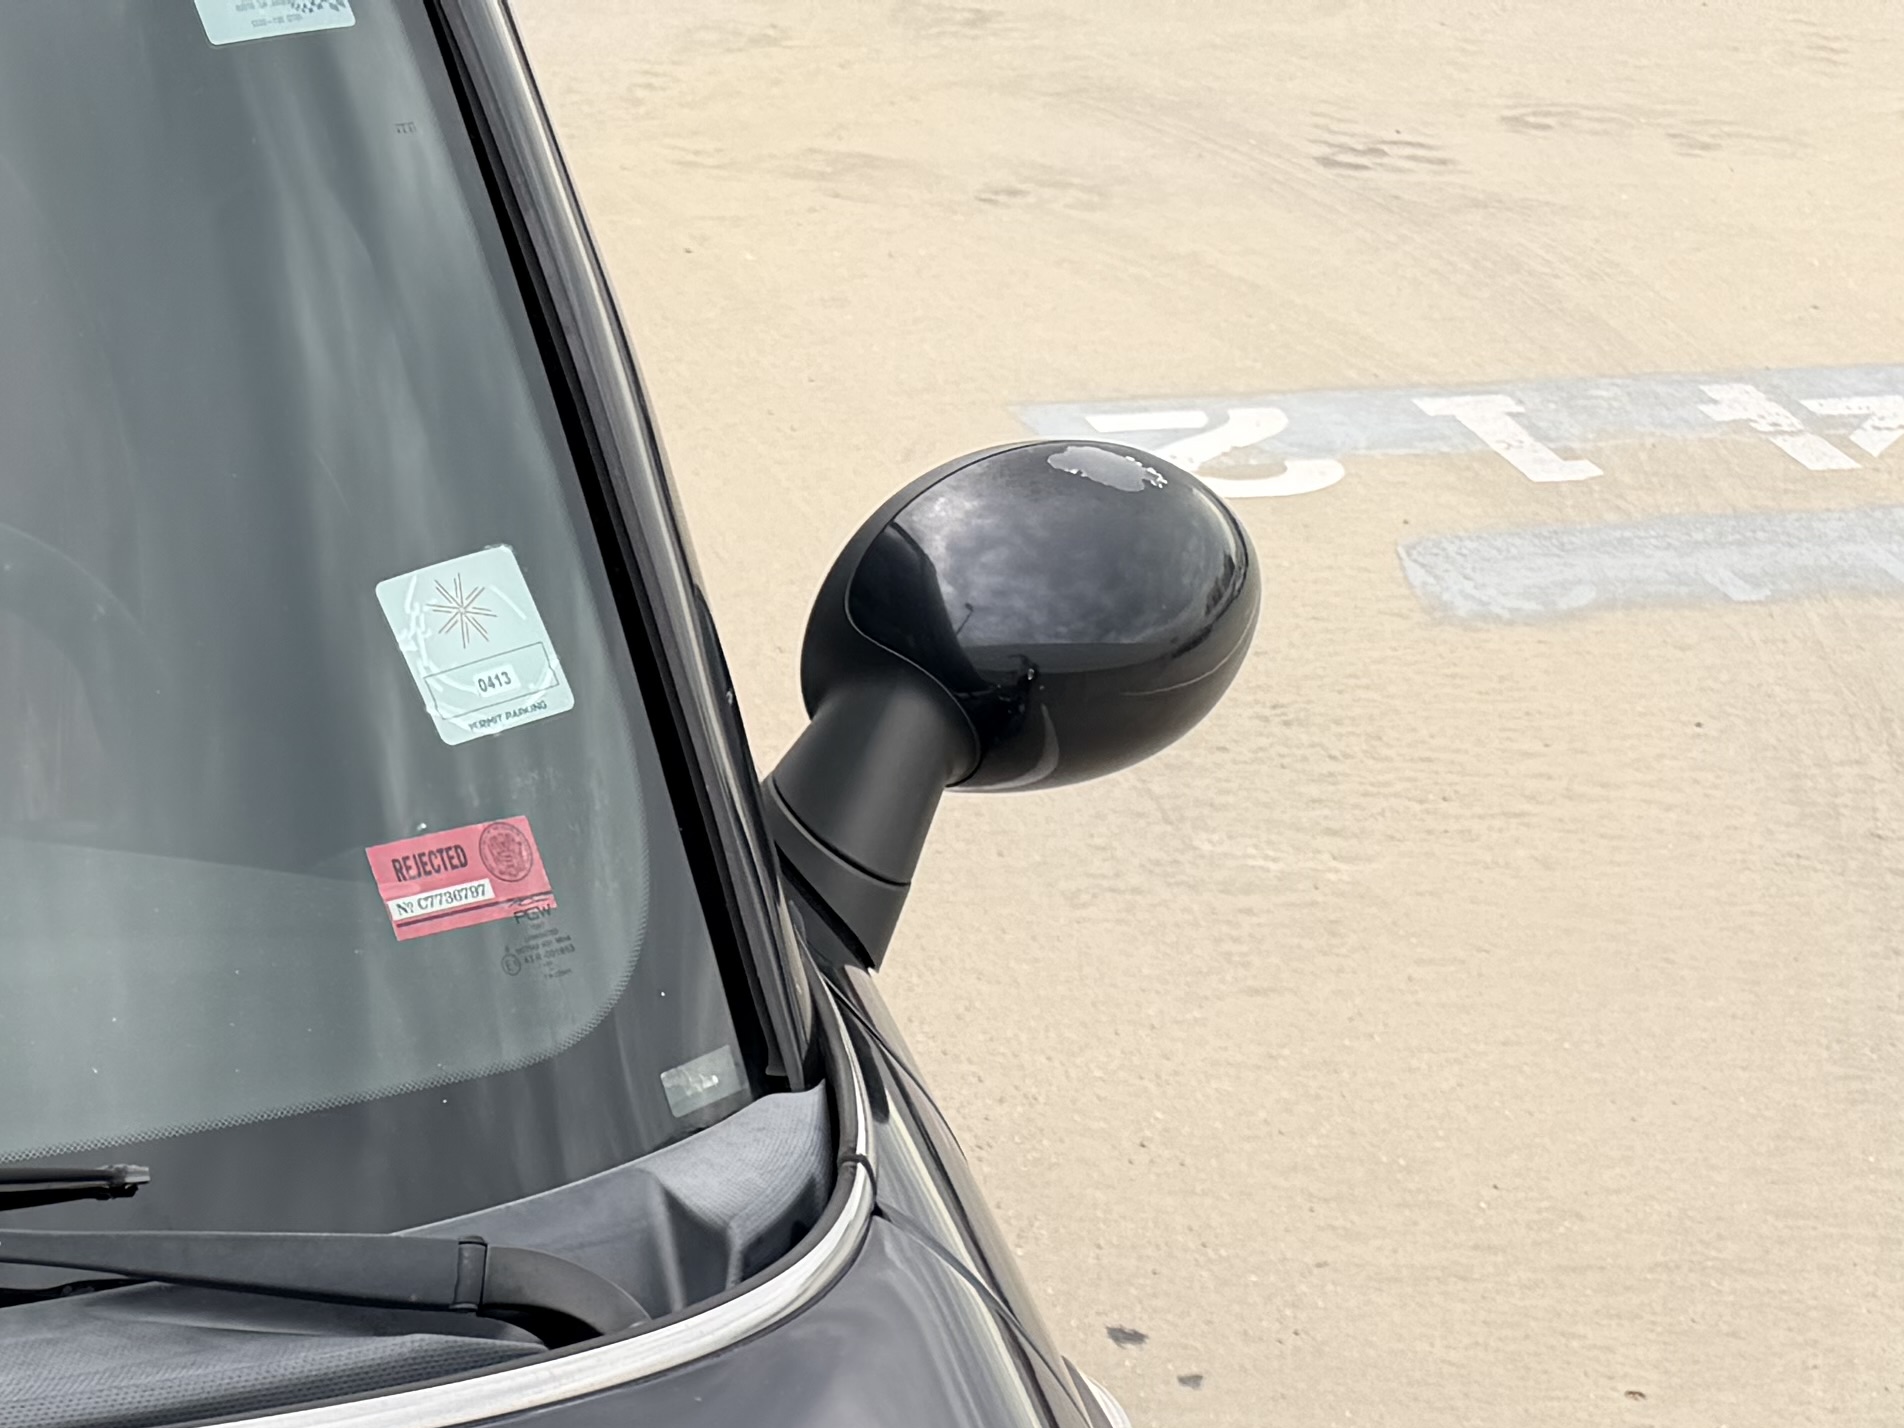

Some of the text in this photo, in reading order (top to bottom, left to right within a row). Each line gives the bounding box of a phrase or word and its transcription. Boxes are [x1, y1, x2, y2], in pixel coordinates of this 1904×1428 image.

[478, 671, 512, 692] 0413
[505, 700, 548, 721] PARKING
[392, 844, 468, 882] REJECTED
